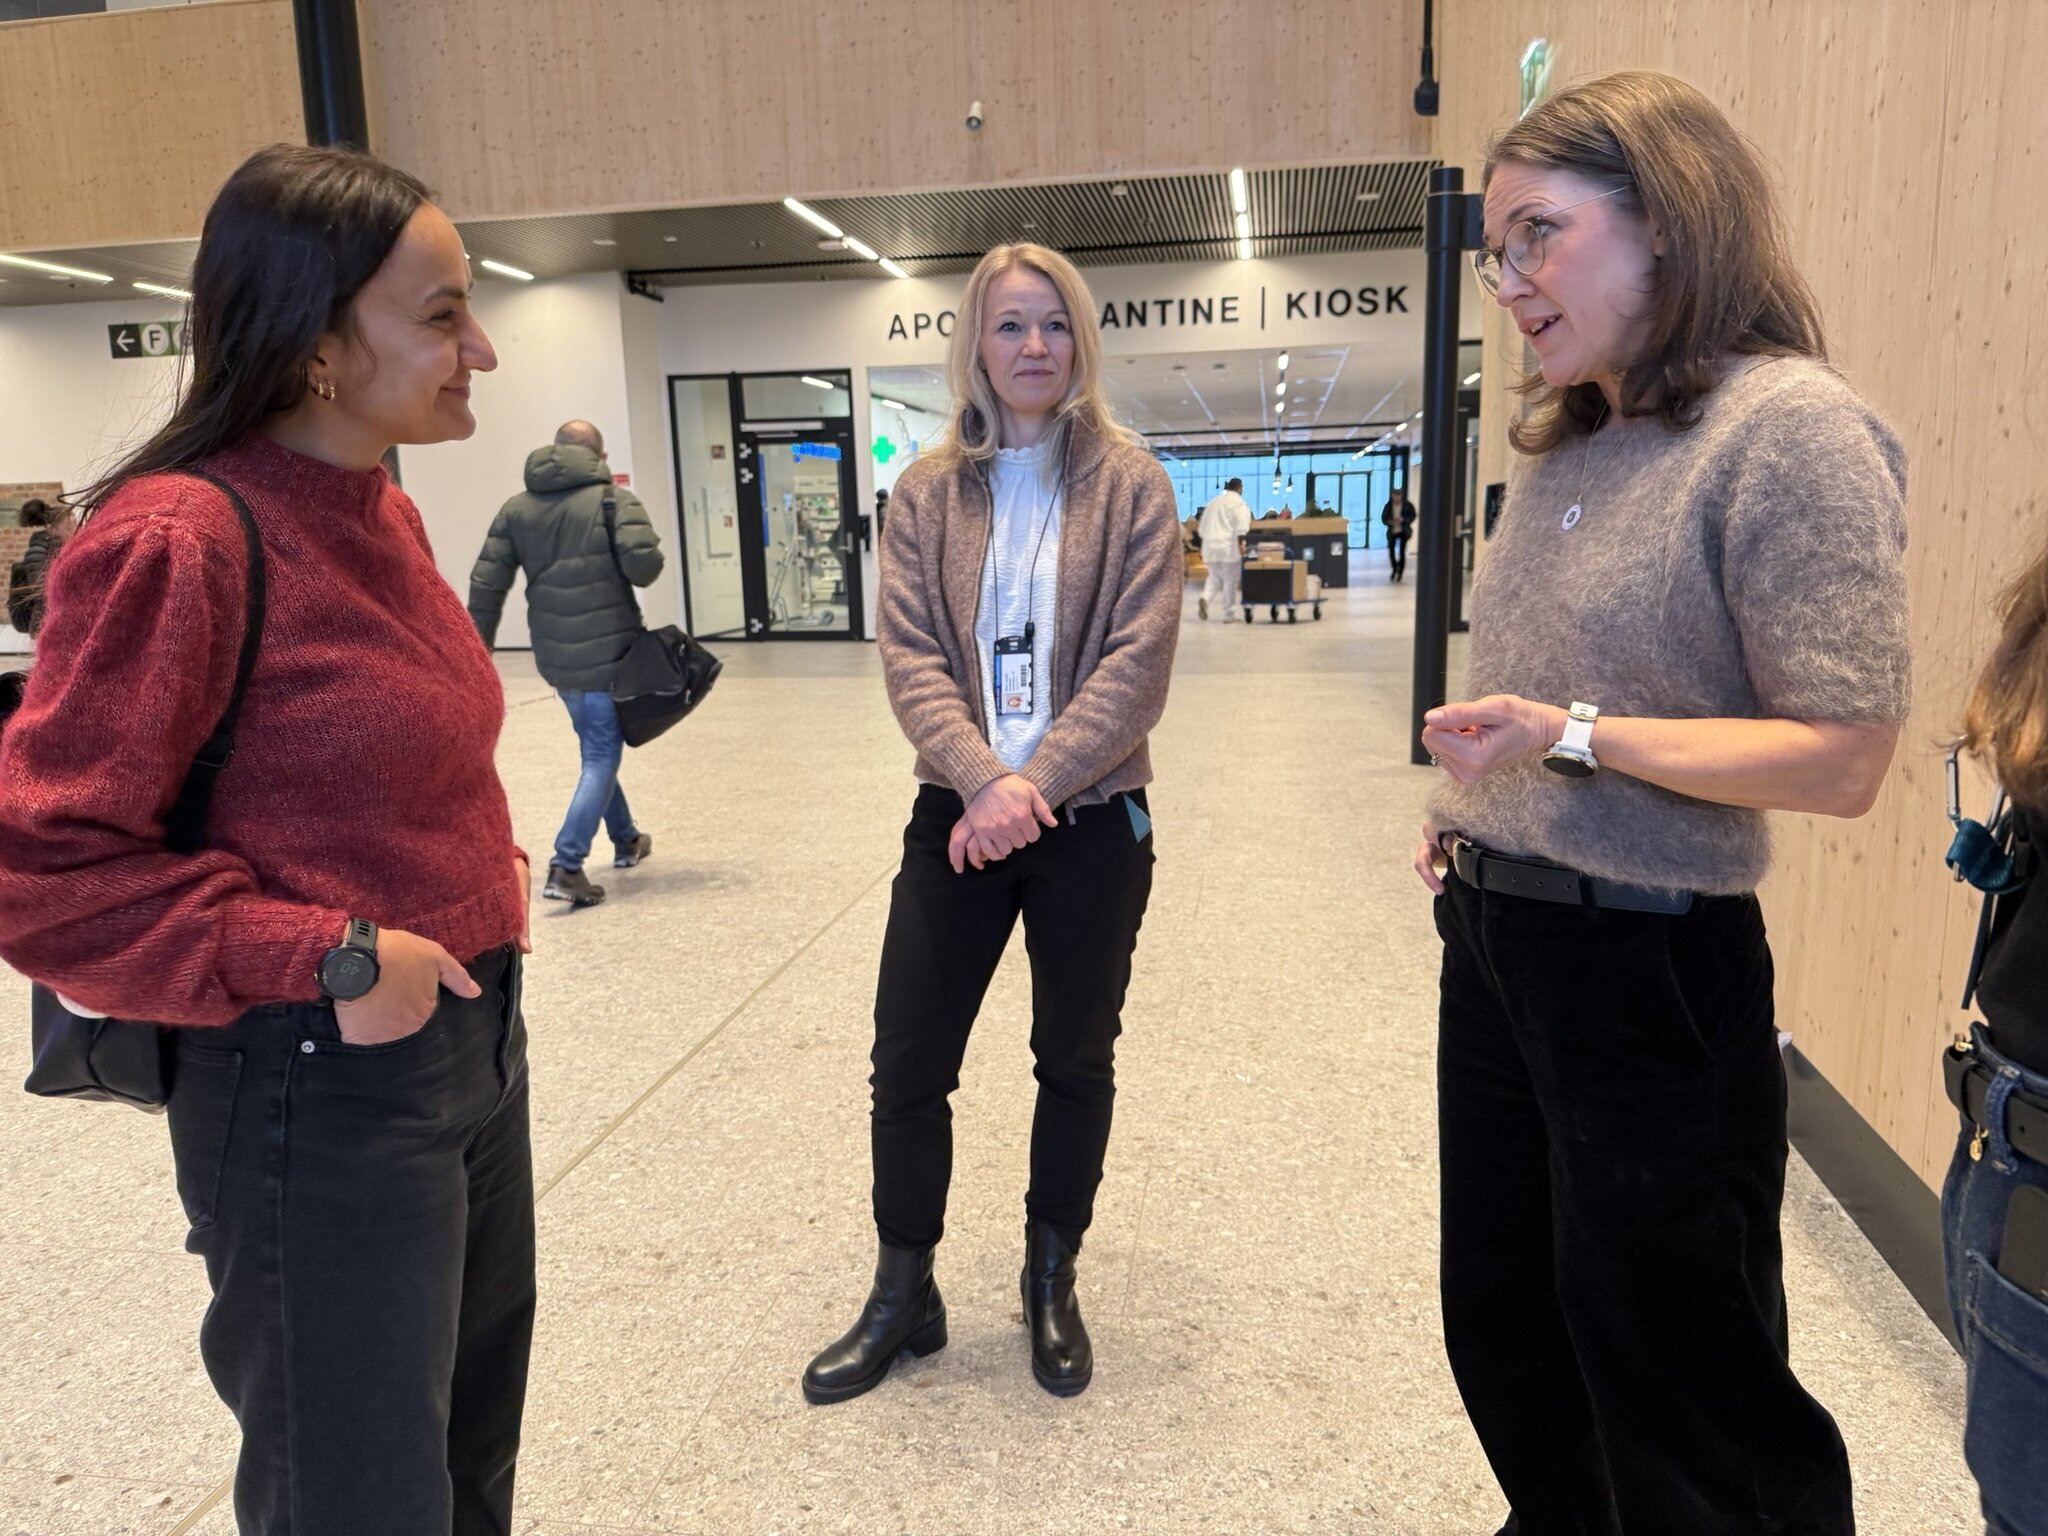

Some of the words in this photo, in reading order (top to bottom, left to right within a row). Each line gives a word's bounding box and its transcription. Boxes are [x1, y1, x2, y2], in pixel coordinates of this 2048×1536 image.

[1099, 296, 1240, 330] ANTINE
[1286, 286, 1409, 320] KIOSK
[149, 331, 161, 350] F
